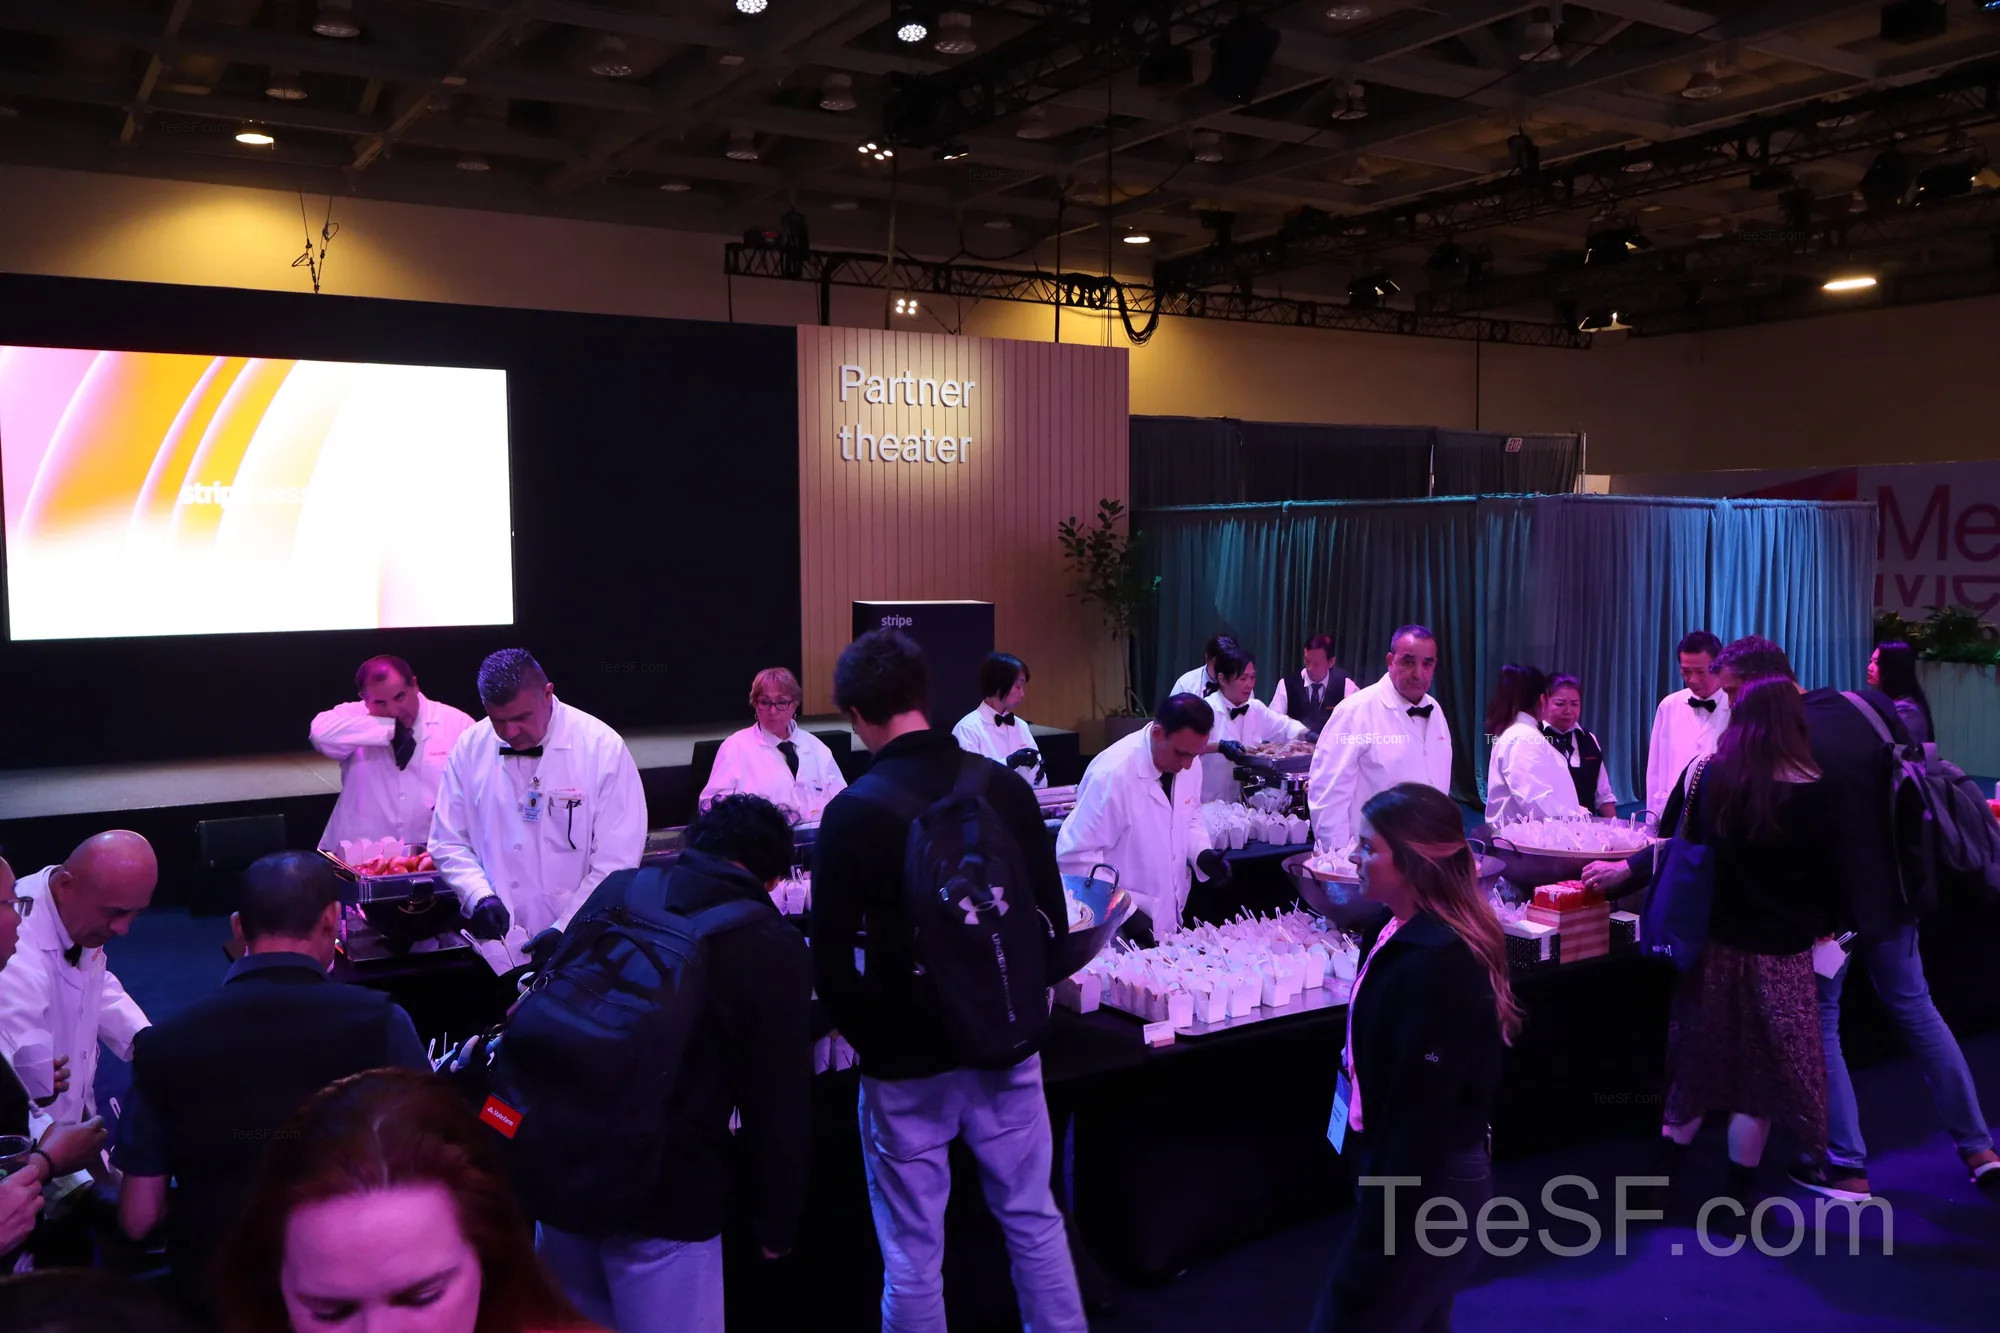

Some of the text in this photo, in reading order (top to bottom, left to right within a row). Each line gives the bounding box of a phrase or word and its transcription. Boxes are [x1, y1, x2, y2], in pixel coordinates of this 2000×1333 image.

[839, 364, 976, 408] Partner
[837, 423, 973, 464] theater
[881, 614, 913, 629] stripe
[1424, 1052, 1439, 1063] alo
